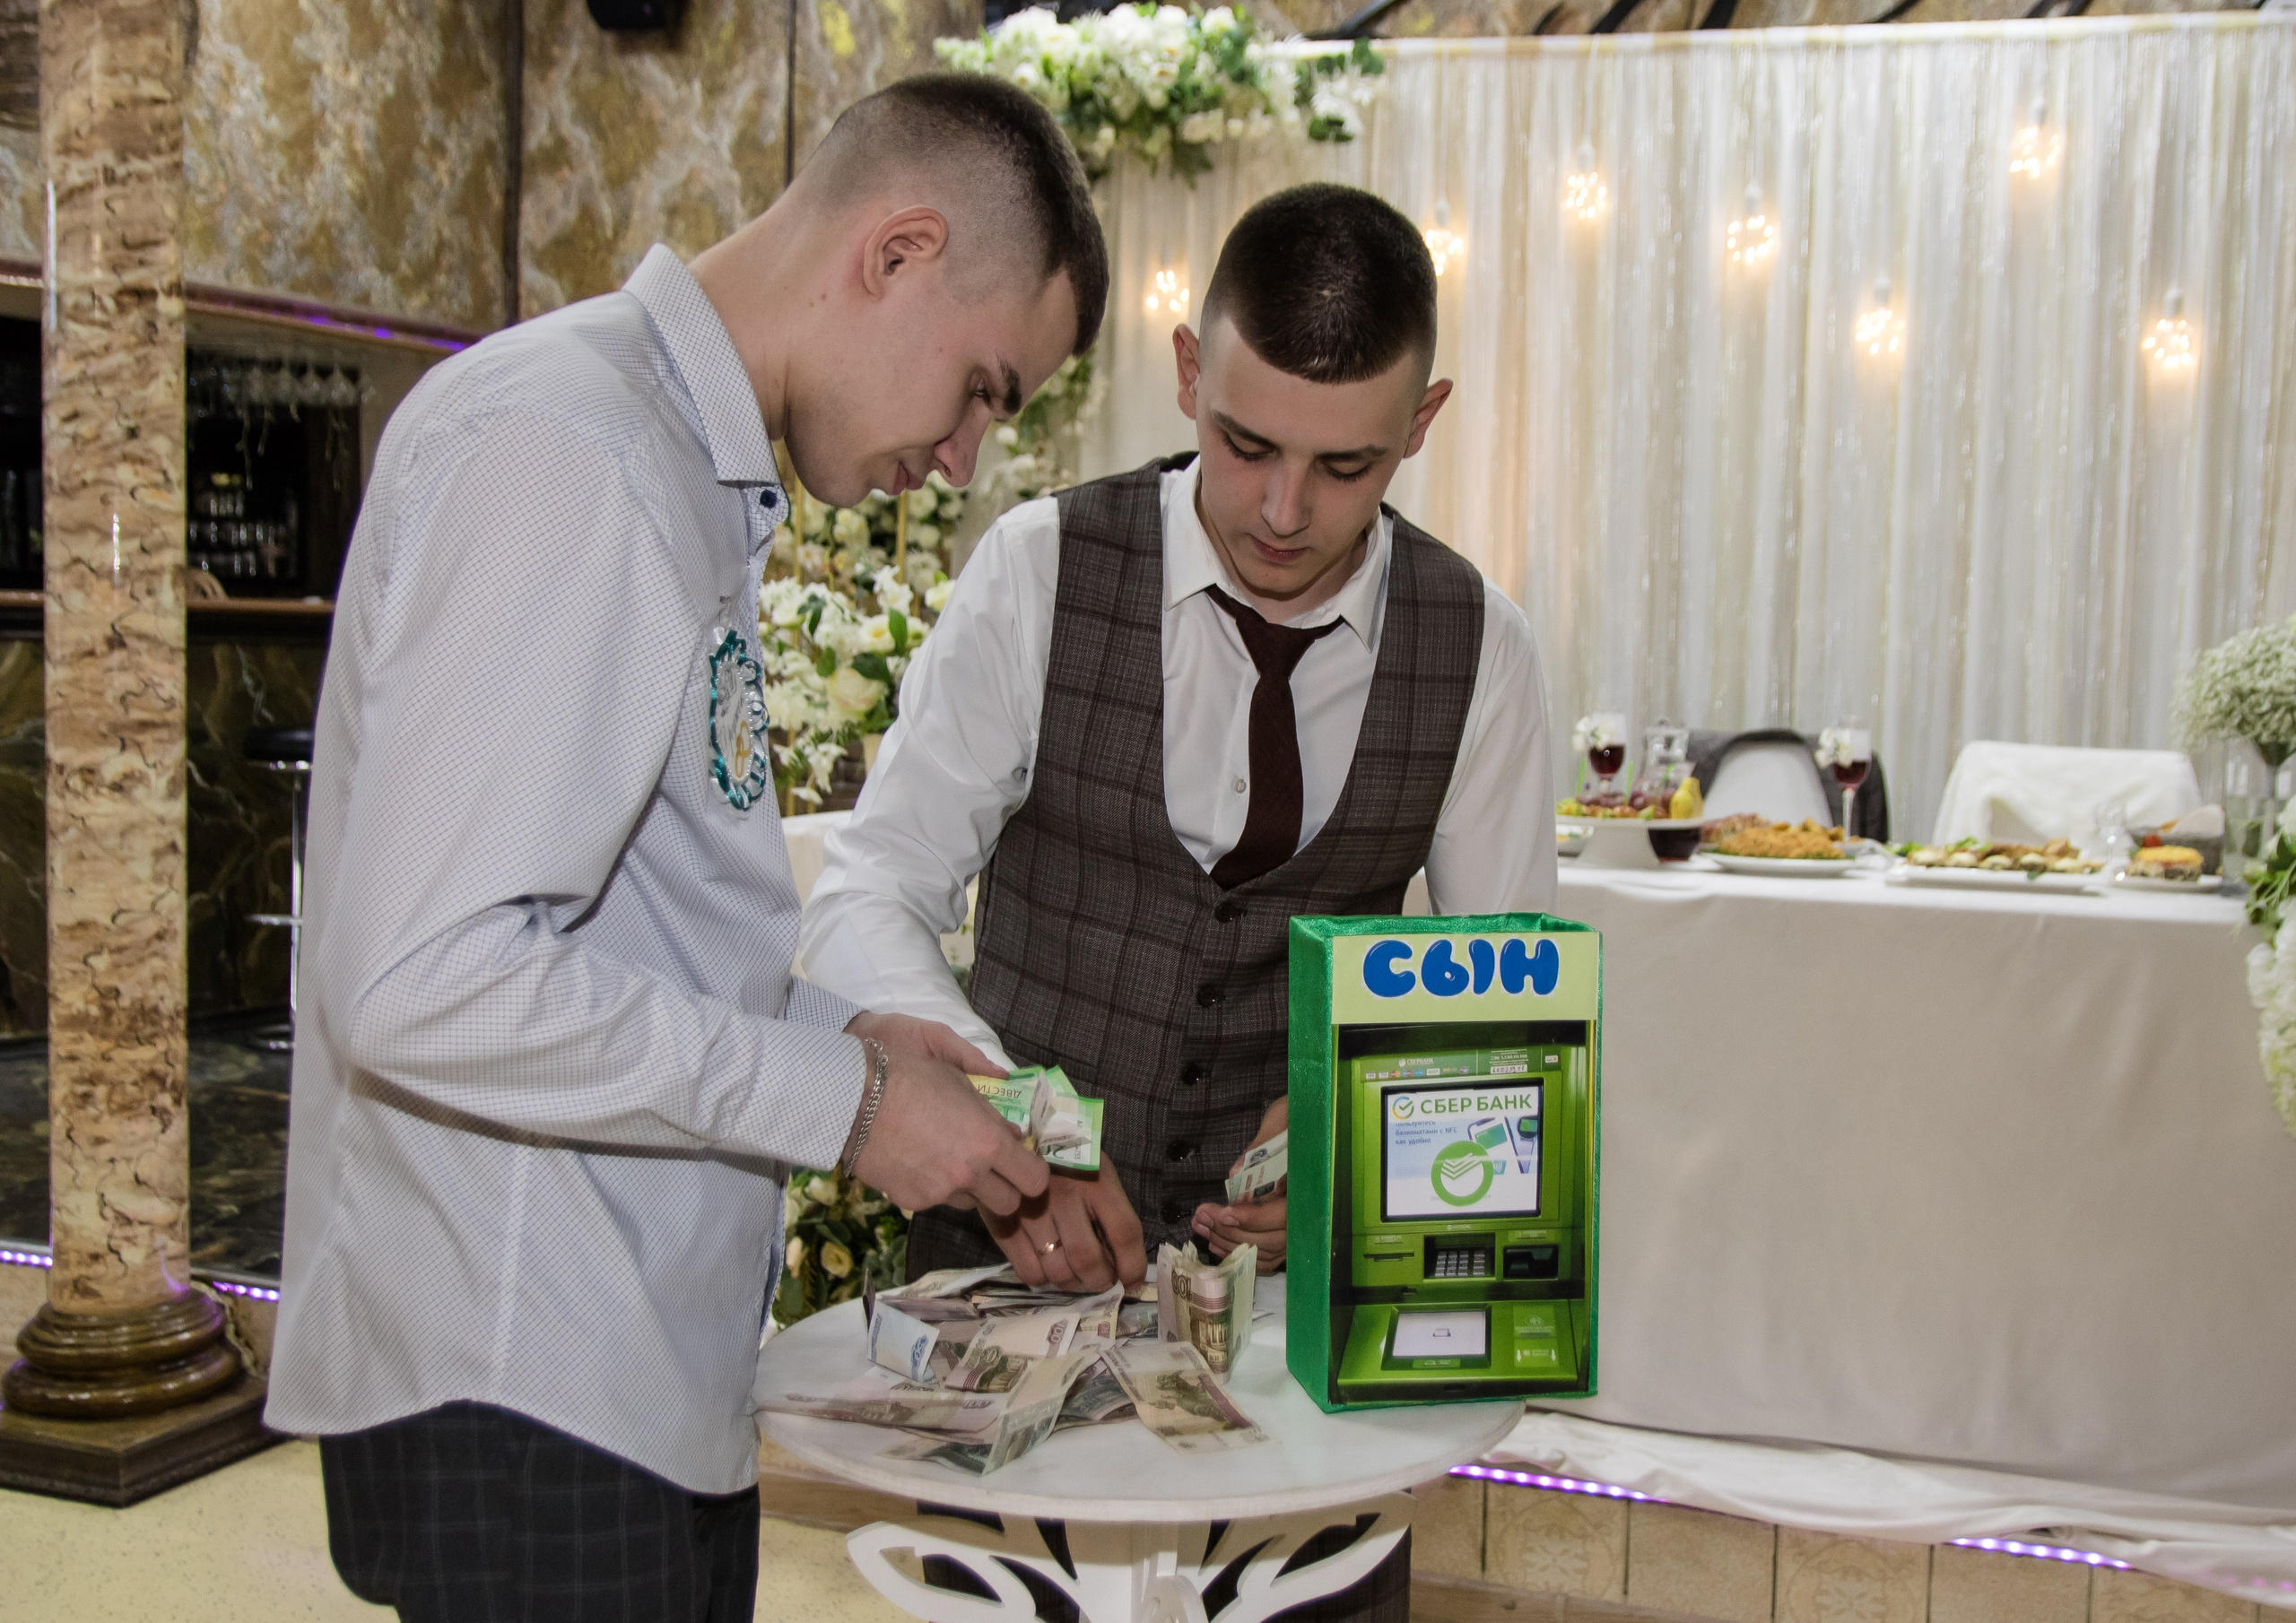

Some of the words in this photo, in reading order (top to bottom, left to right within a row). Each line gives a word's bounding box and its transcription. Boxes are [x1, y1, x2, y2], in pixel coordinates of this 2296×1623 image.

[1362, 939, 1560, 998] СЫН
[978, 1083, 1022, 1098] ДВЕСТИ
[1421, 1098, 1472, 1114] СБЕР
[1477, 1094, 1532, 1111] БАНК
[1049, 1323, 1066, 1344] 100
